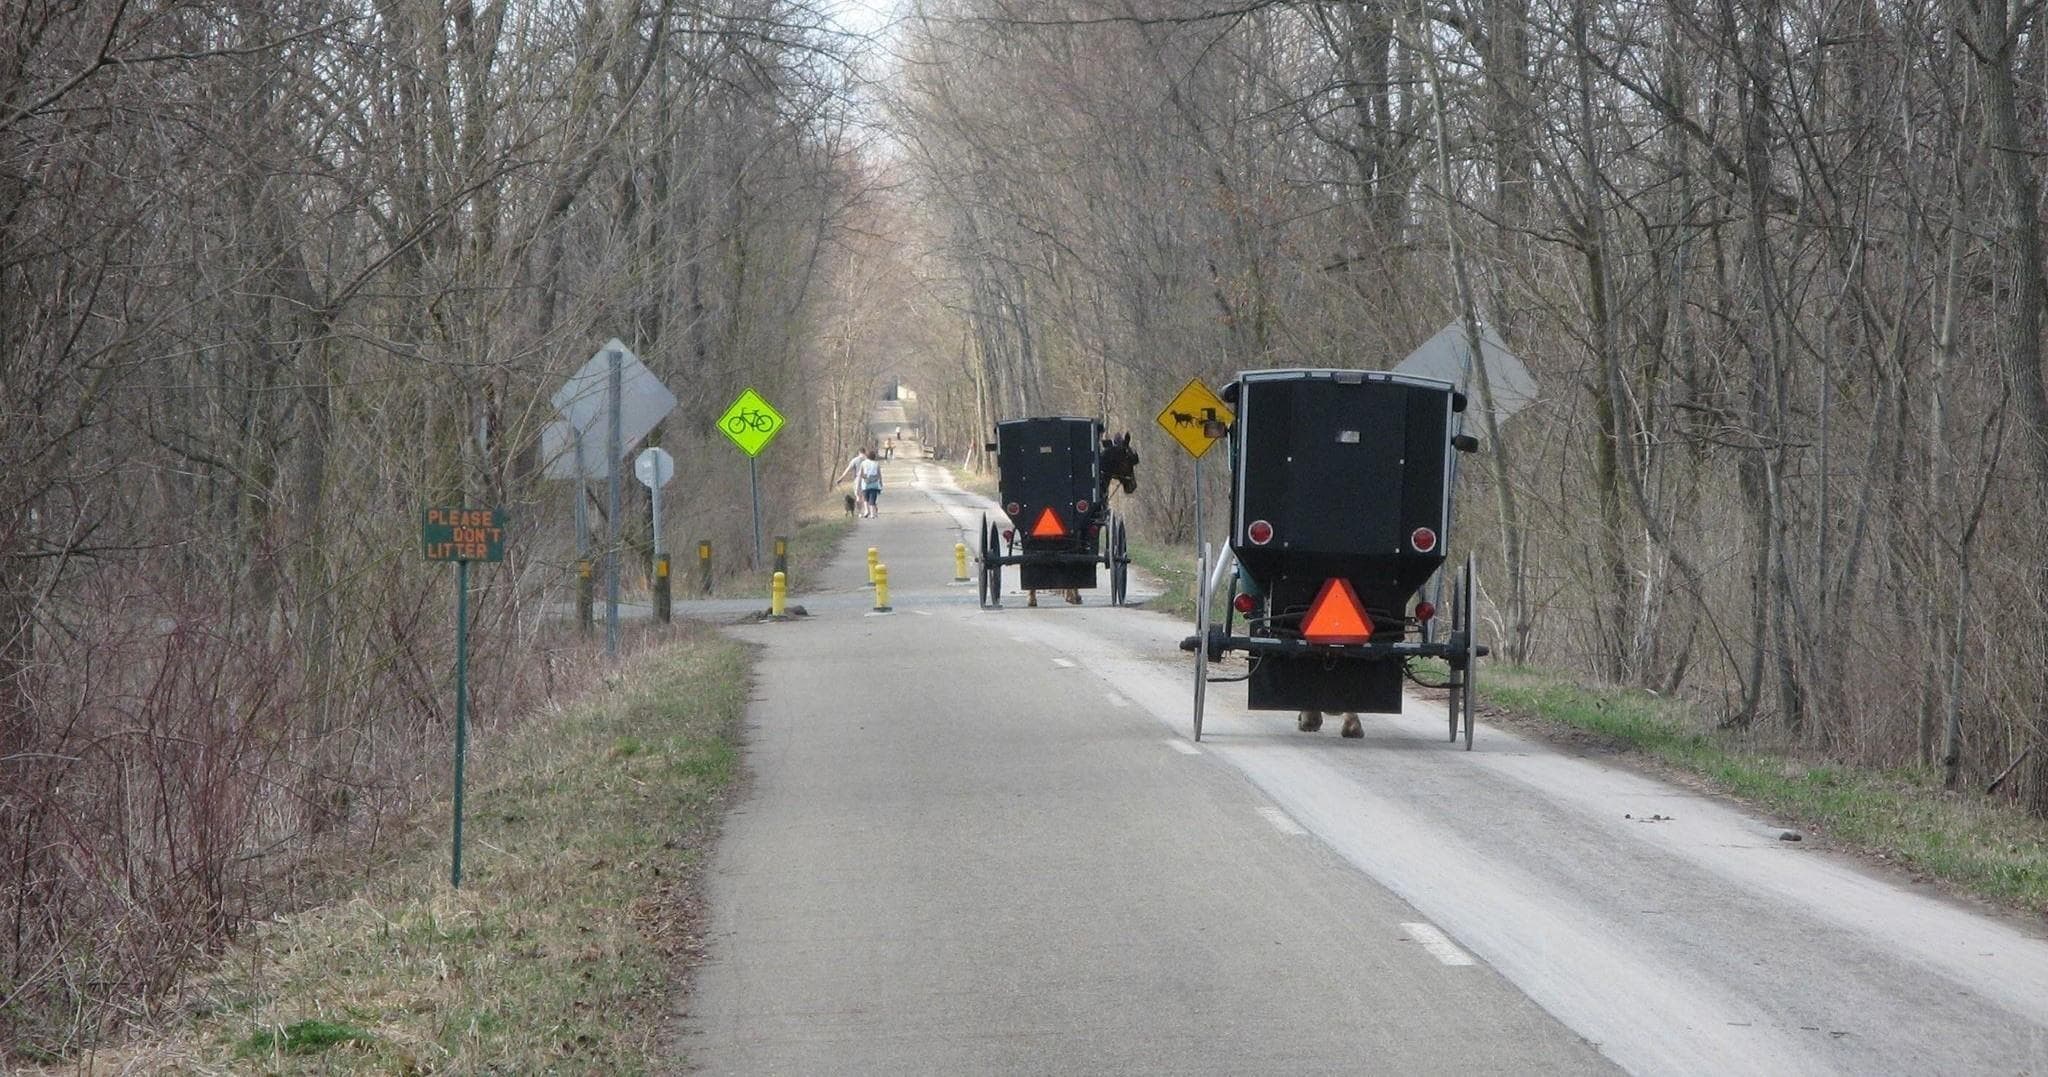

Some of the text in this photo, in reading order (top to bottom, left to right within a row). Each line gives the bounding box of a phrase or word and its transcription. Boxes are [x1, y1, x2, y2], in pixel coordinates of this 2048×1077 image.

[428, 510, 493, 526] PLEASE
[453, 527, 501, 543] DON'T
[428, 543, 487, 558] LITTER
